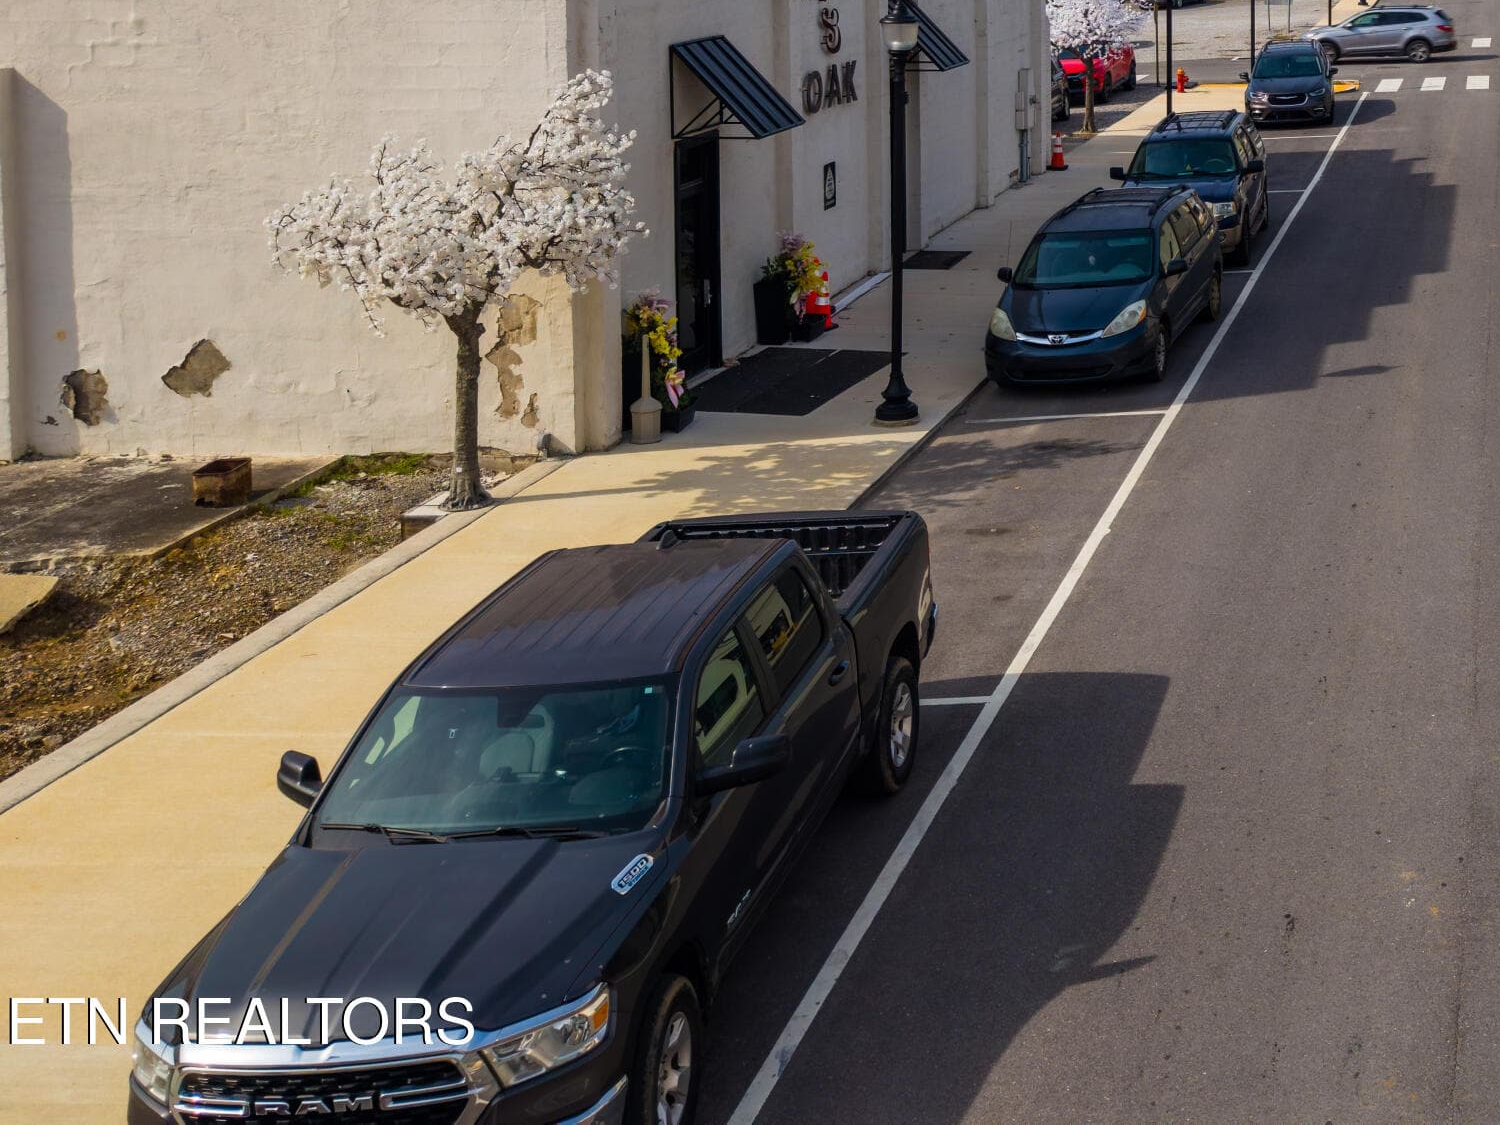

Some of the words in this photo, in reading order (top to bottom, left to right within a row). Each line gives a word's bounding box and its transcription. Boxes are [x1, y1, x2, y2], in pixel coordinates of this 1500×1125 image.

[803, 60, 858, 114] OAK
[618, 858, 647, 886] 1500
[254, 1095, 374, 1116] RAM
